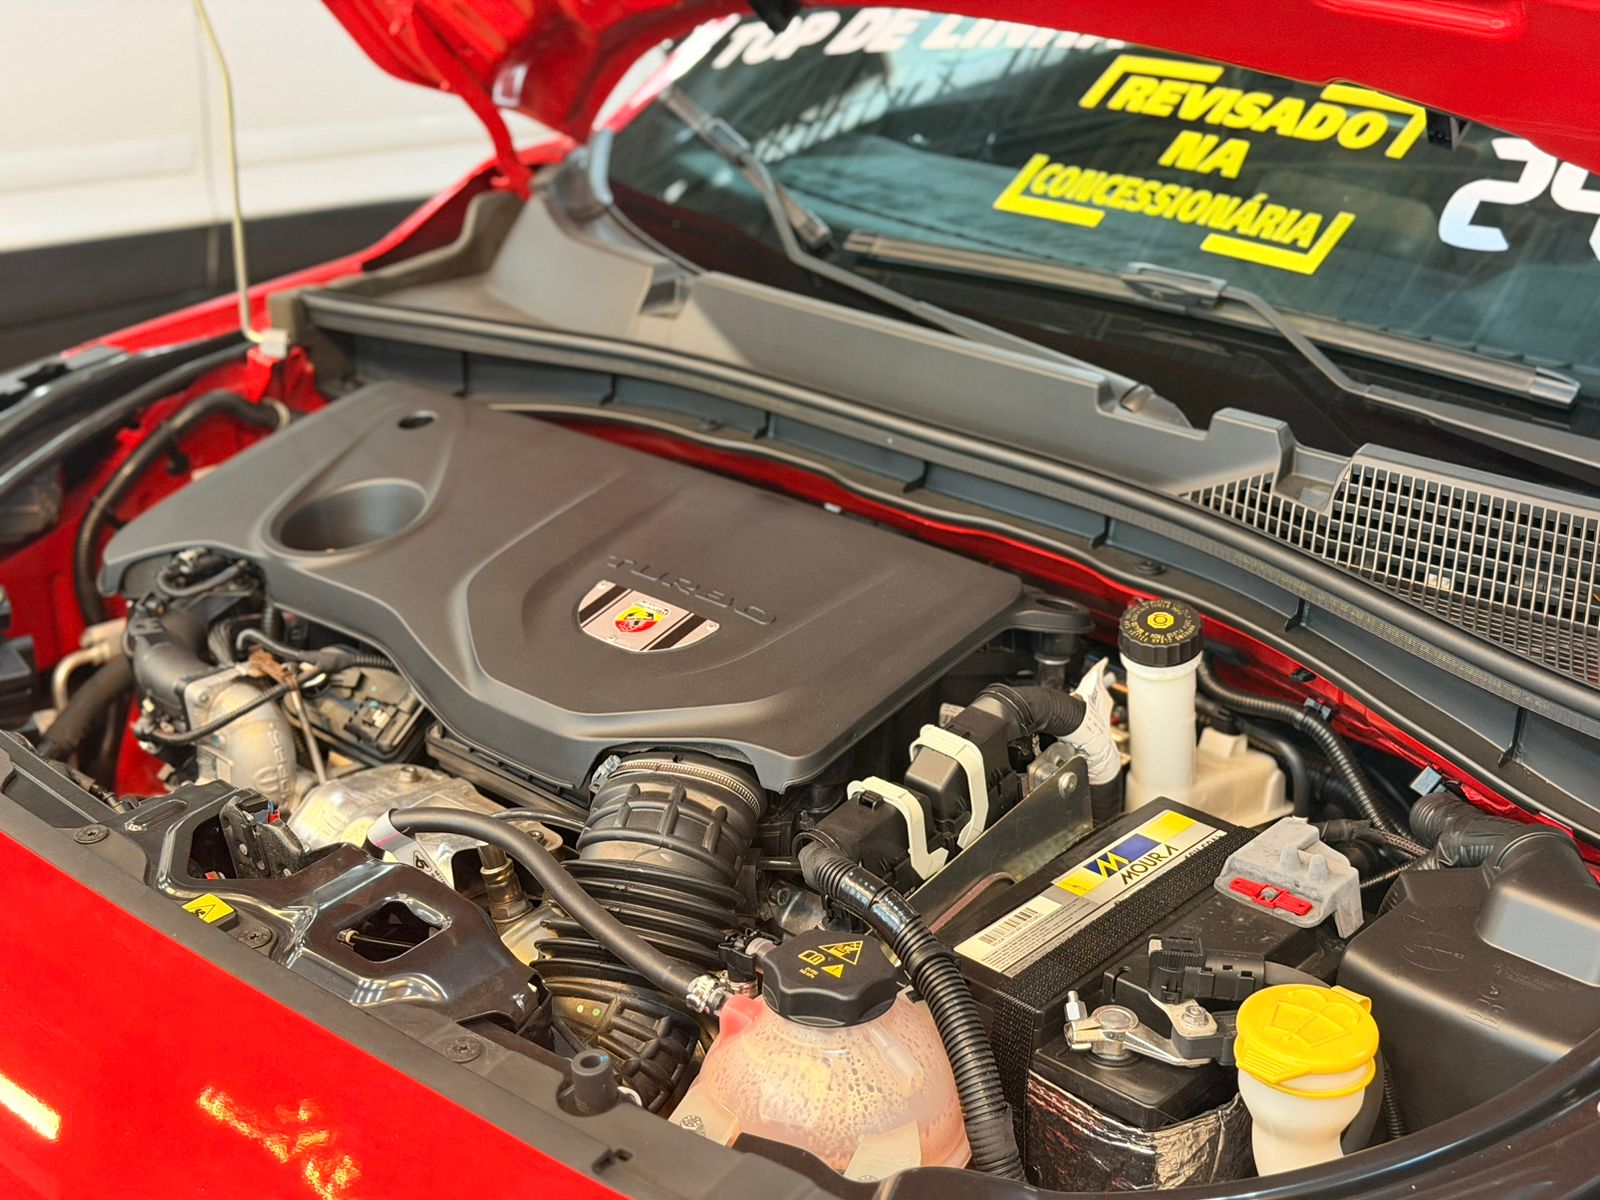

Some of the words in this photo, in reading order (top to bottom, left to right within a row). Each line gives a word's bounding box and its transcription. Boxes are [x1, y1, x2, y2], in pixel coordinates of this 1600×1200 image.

[823, 7, 932, 55] DE
[1107, 75, 1389, 149] REVISADO
[1158, 130, 1250, 178] NA
[1030, 163, 1322, 248] CONCESSIONÁRIA
[607, 554, 776, 626] TURBO
[1120, 843, 1180, 885] MOURA
